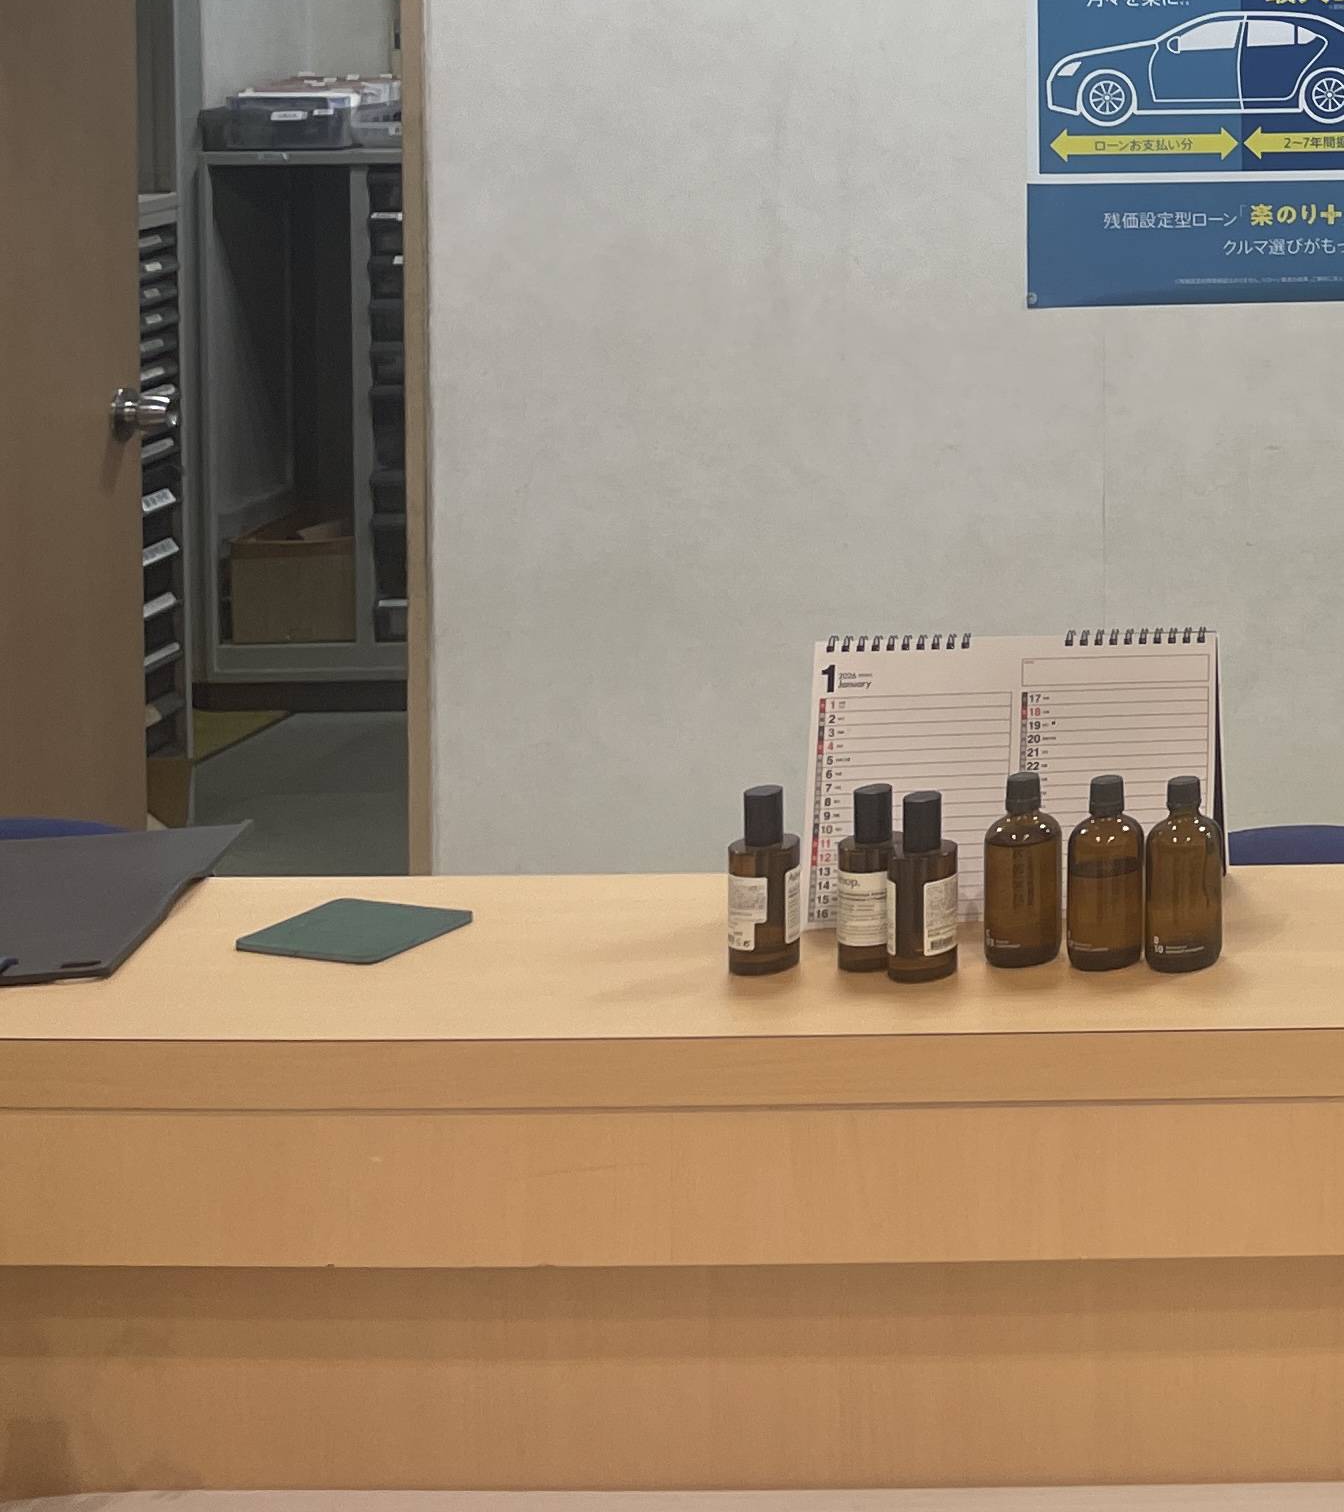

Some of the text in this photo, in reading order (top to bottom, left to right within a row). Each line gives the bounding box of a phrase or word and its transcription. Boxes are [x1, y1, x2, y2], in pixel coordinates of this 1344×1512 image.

[1094, 138, 1193, 153] ローンお支払い分
[821, 665, 836, 693] 1
[837, 679, 872, 690] January
